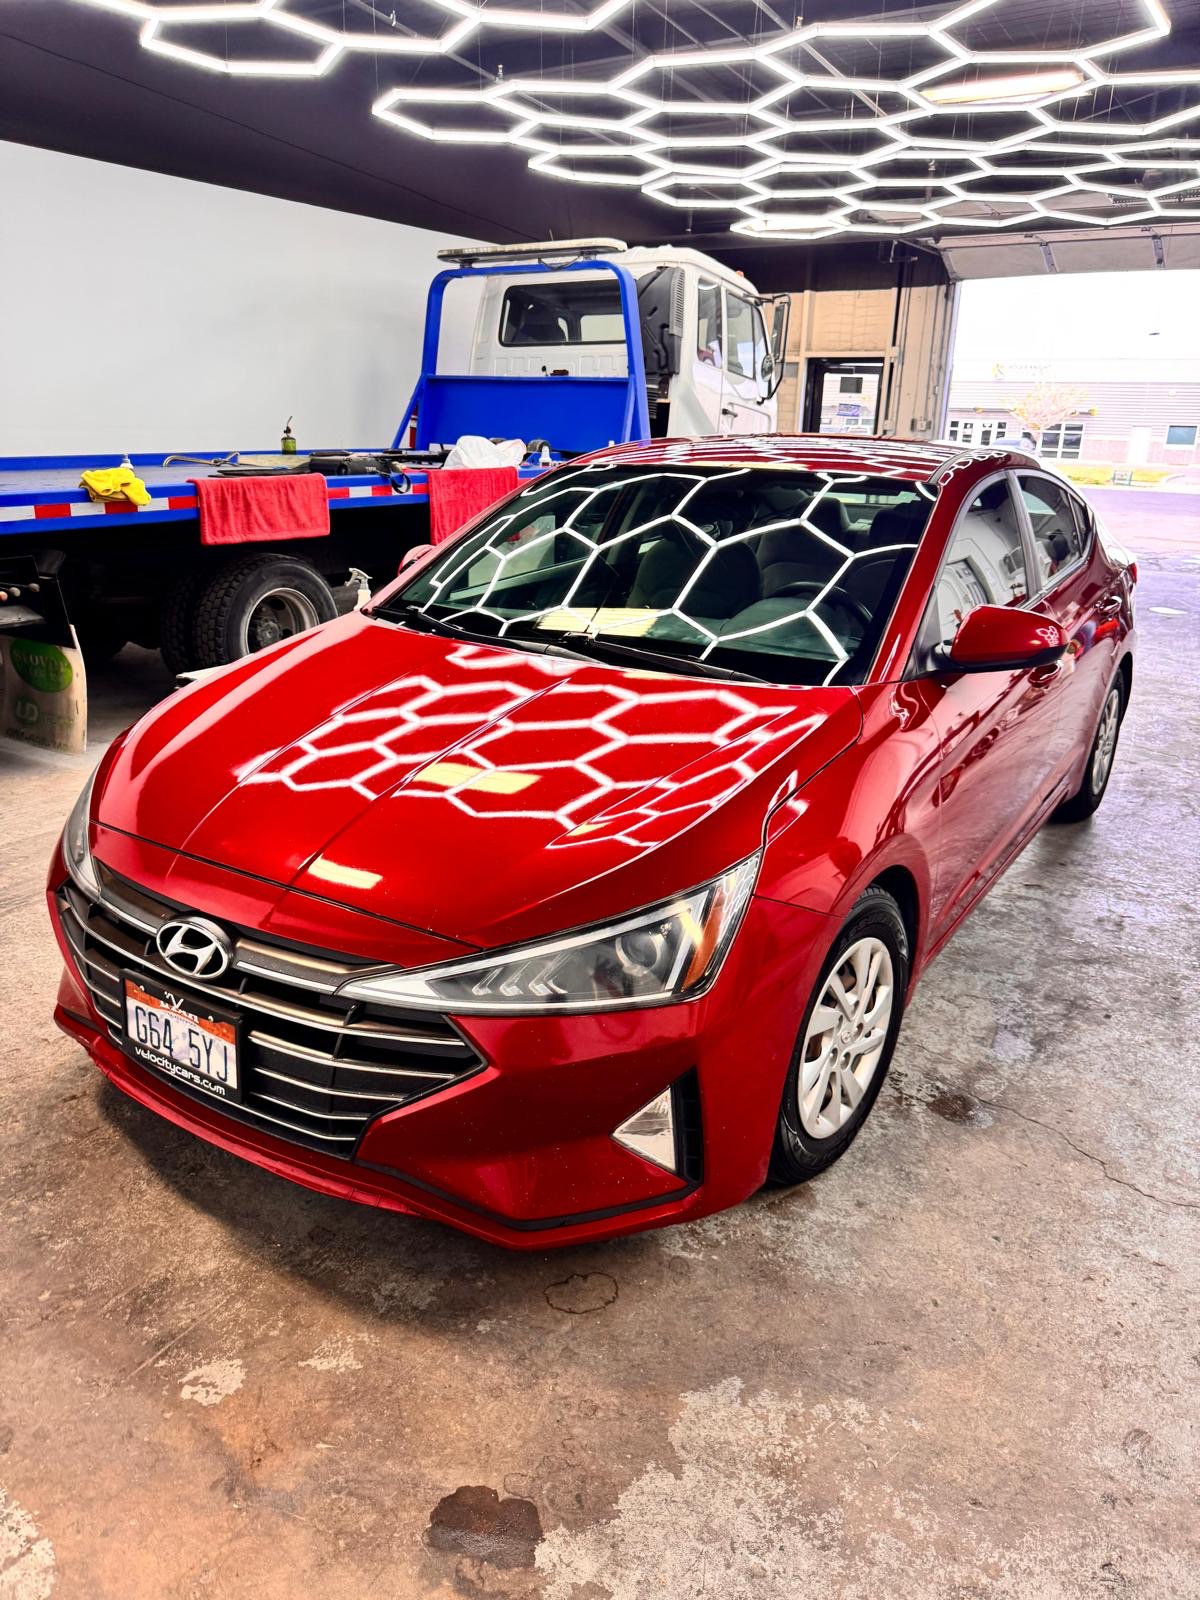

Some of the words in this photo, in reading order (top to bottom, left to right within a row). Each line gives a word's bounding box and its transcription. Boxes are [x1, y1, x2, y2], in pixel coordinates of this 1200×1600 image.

[134, 1046, 226, 1096] velocitycars.com
[135, 1005, 174, 1057] G64
[188, 1028, 228, 1083] 5YJ
